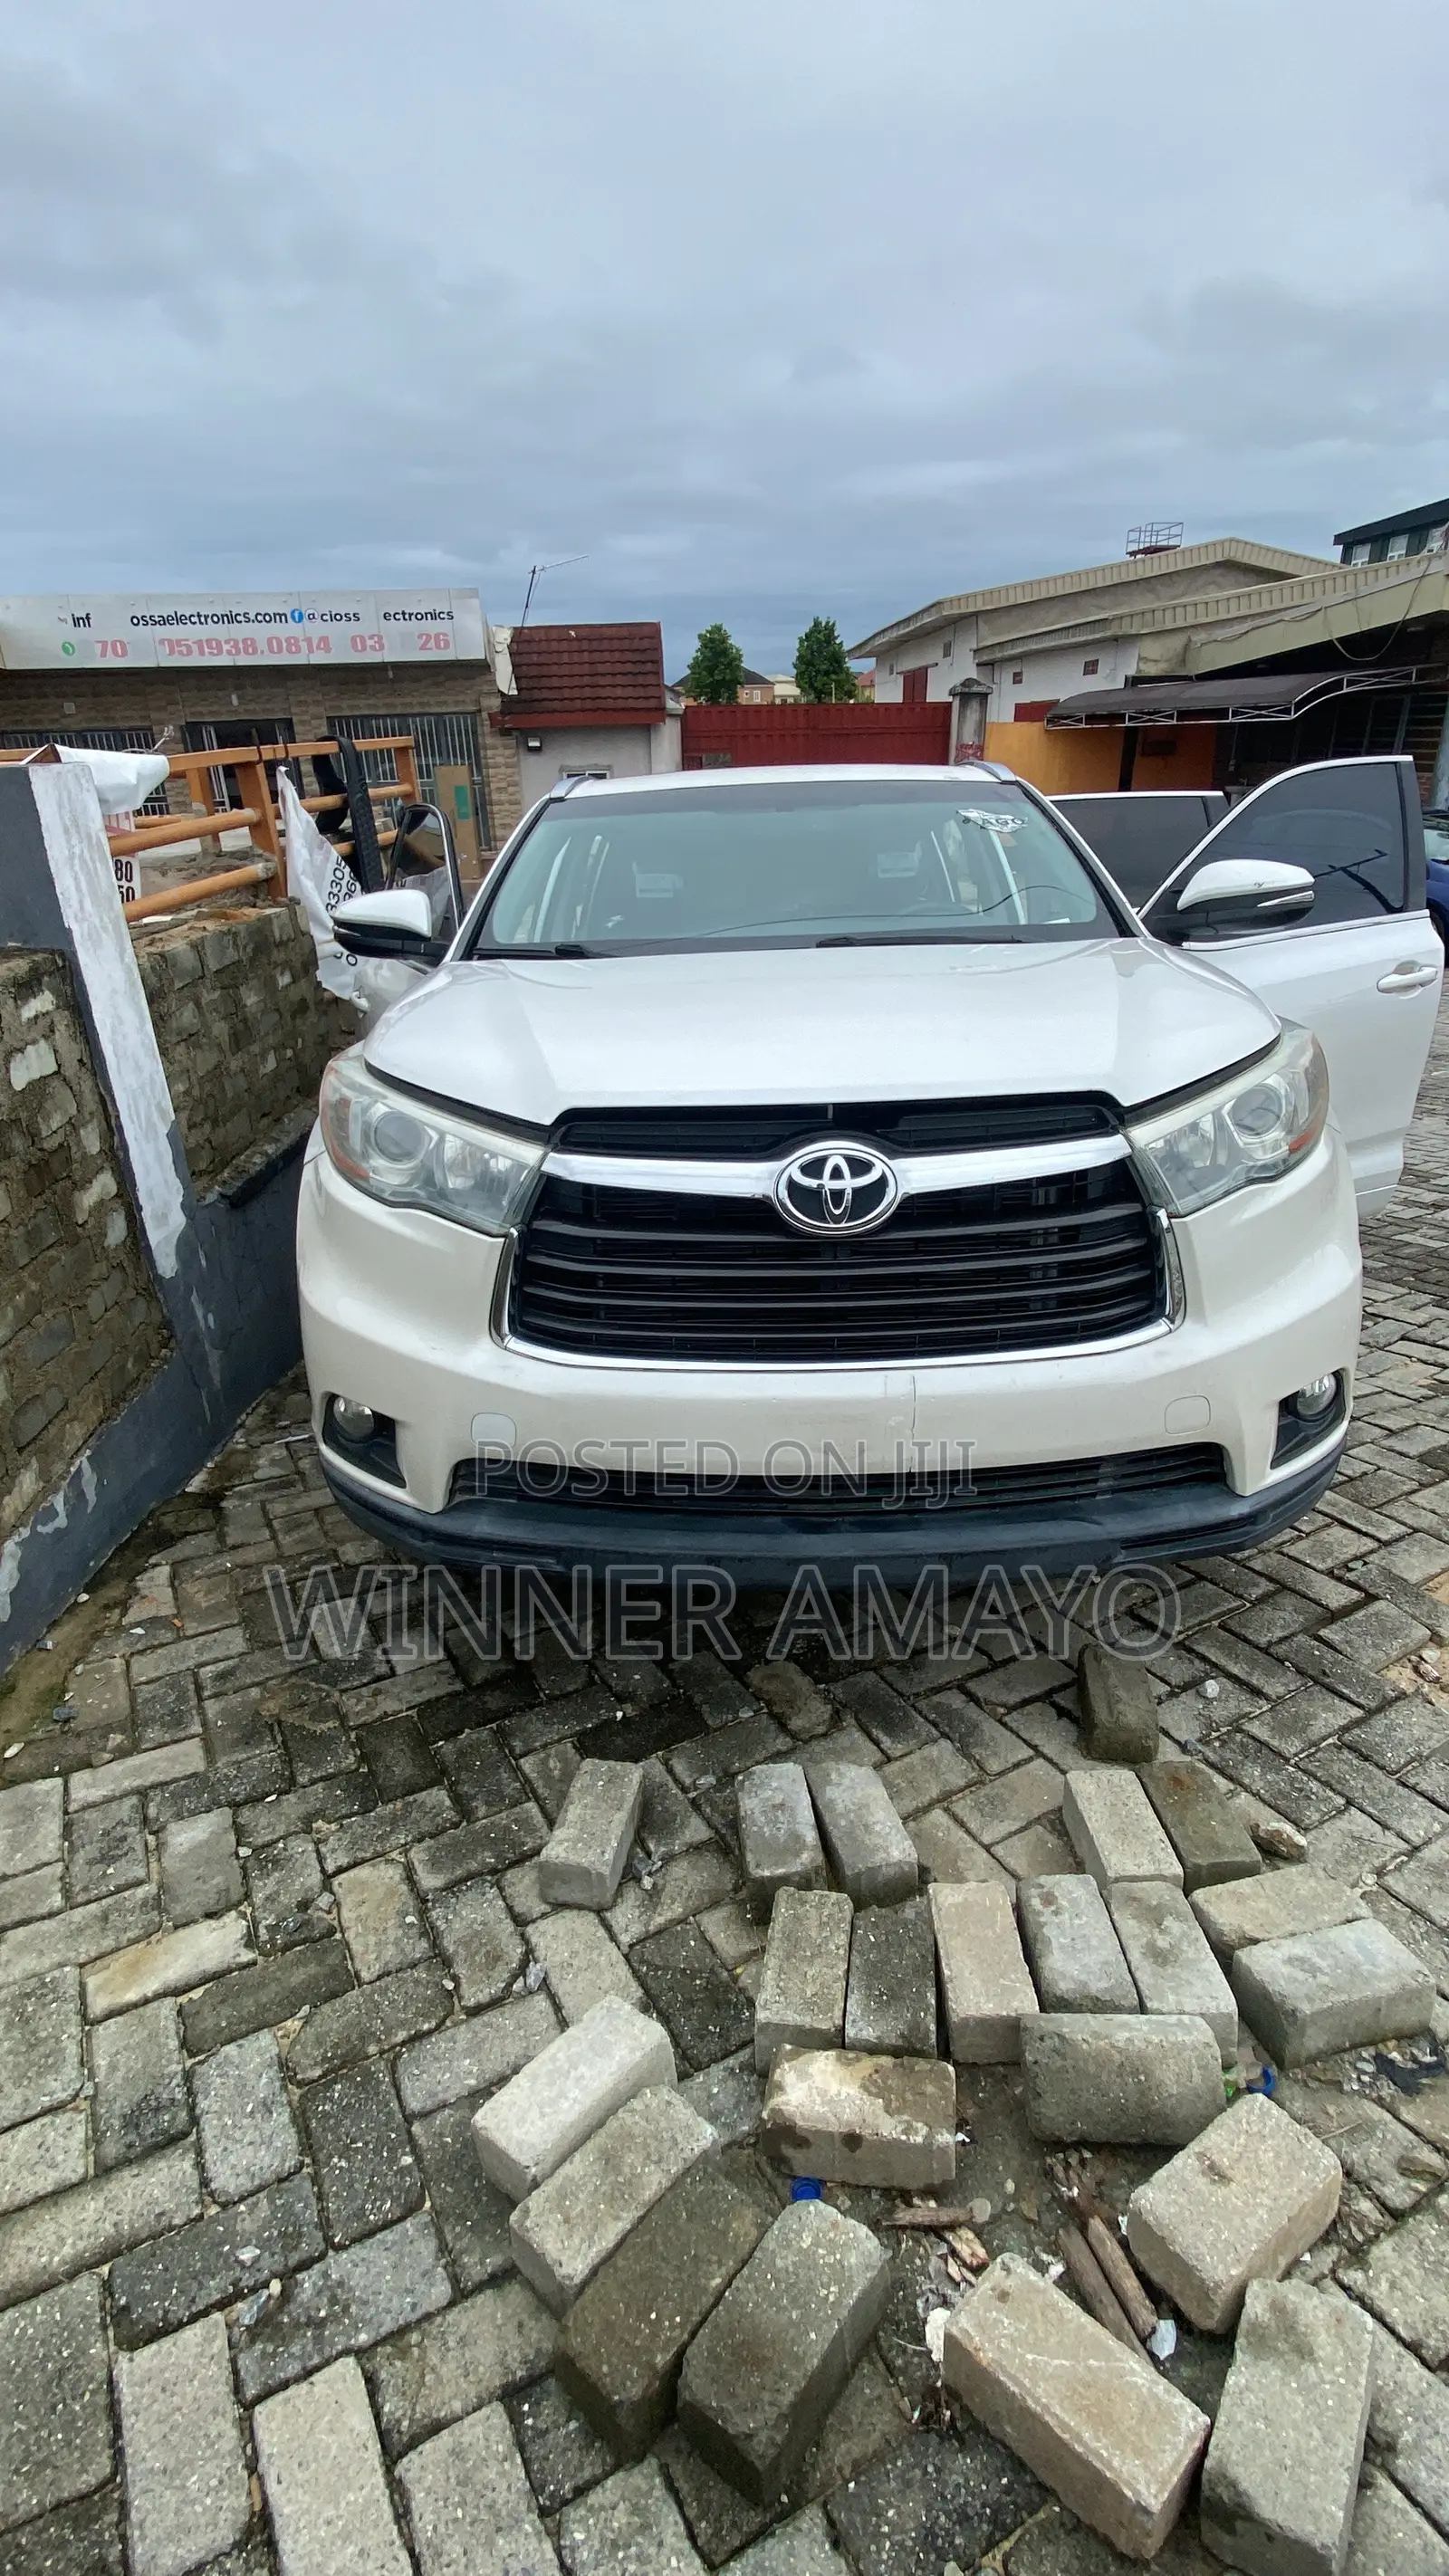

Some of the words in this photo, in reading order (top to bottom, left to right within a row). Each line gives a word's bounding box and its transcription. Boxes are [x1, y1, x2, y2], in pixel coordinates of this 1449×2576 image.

[72, 613, 91, 627] inf
[383, 609, 454, 621] ectronics
[417, 633, 450, 651] 26
